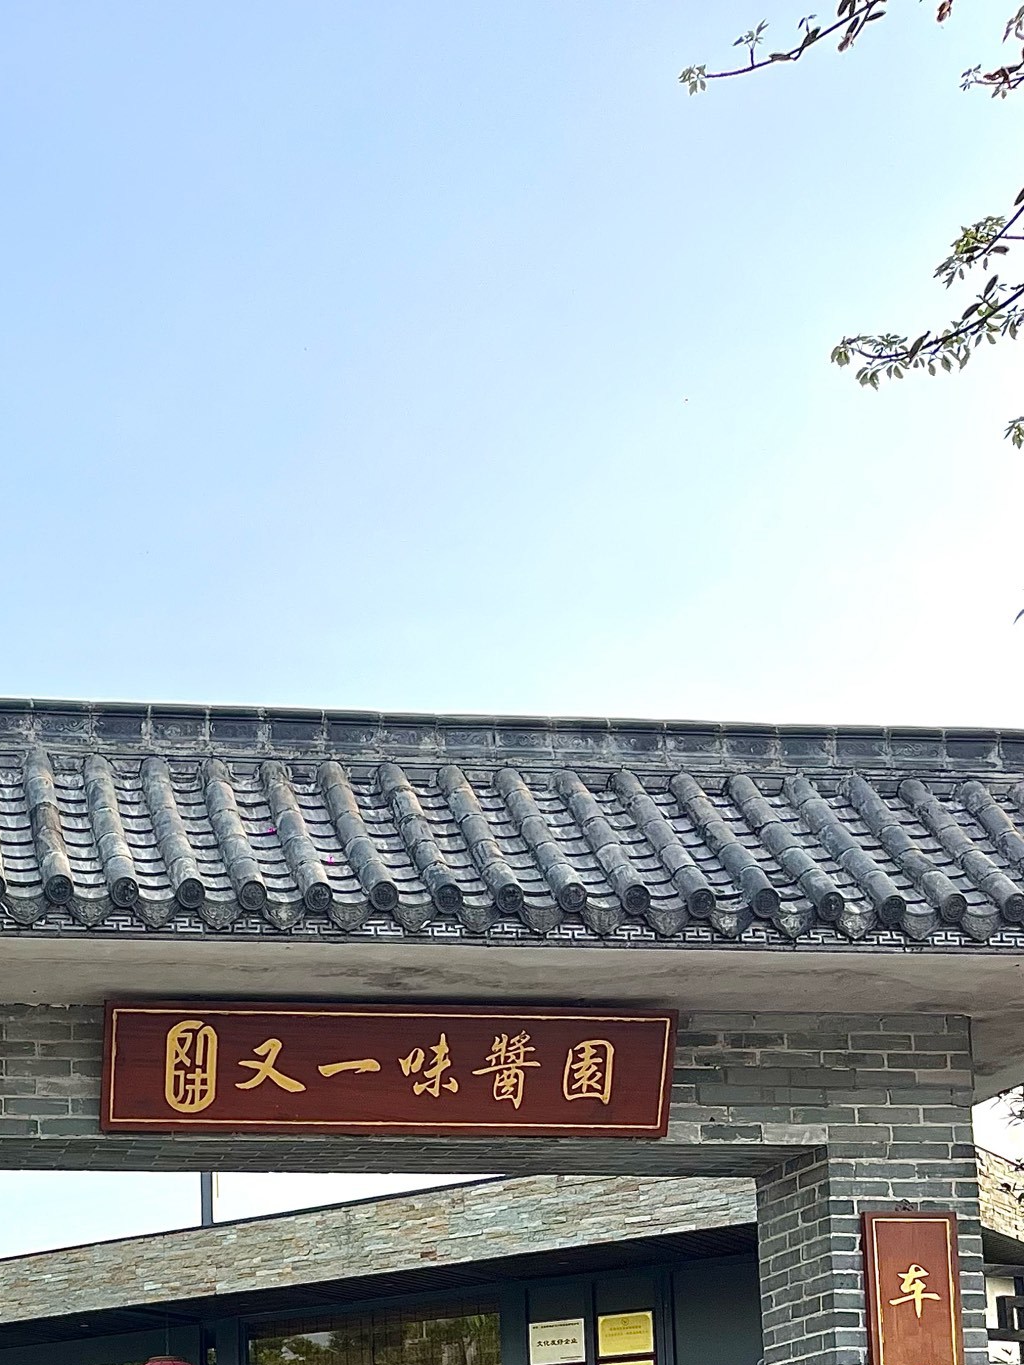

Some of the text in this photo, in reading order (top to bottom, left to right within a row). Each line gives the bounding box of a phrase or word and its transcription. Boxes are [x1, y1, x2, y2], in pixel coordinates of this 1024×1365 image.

[235, 1030, 615, 1110] 又一味醬園
